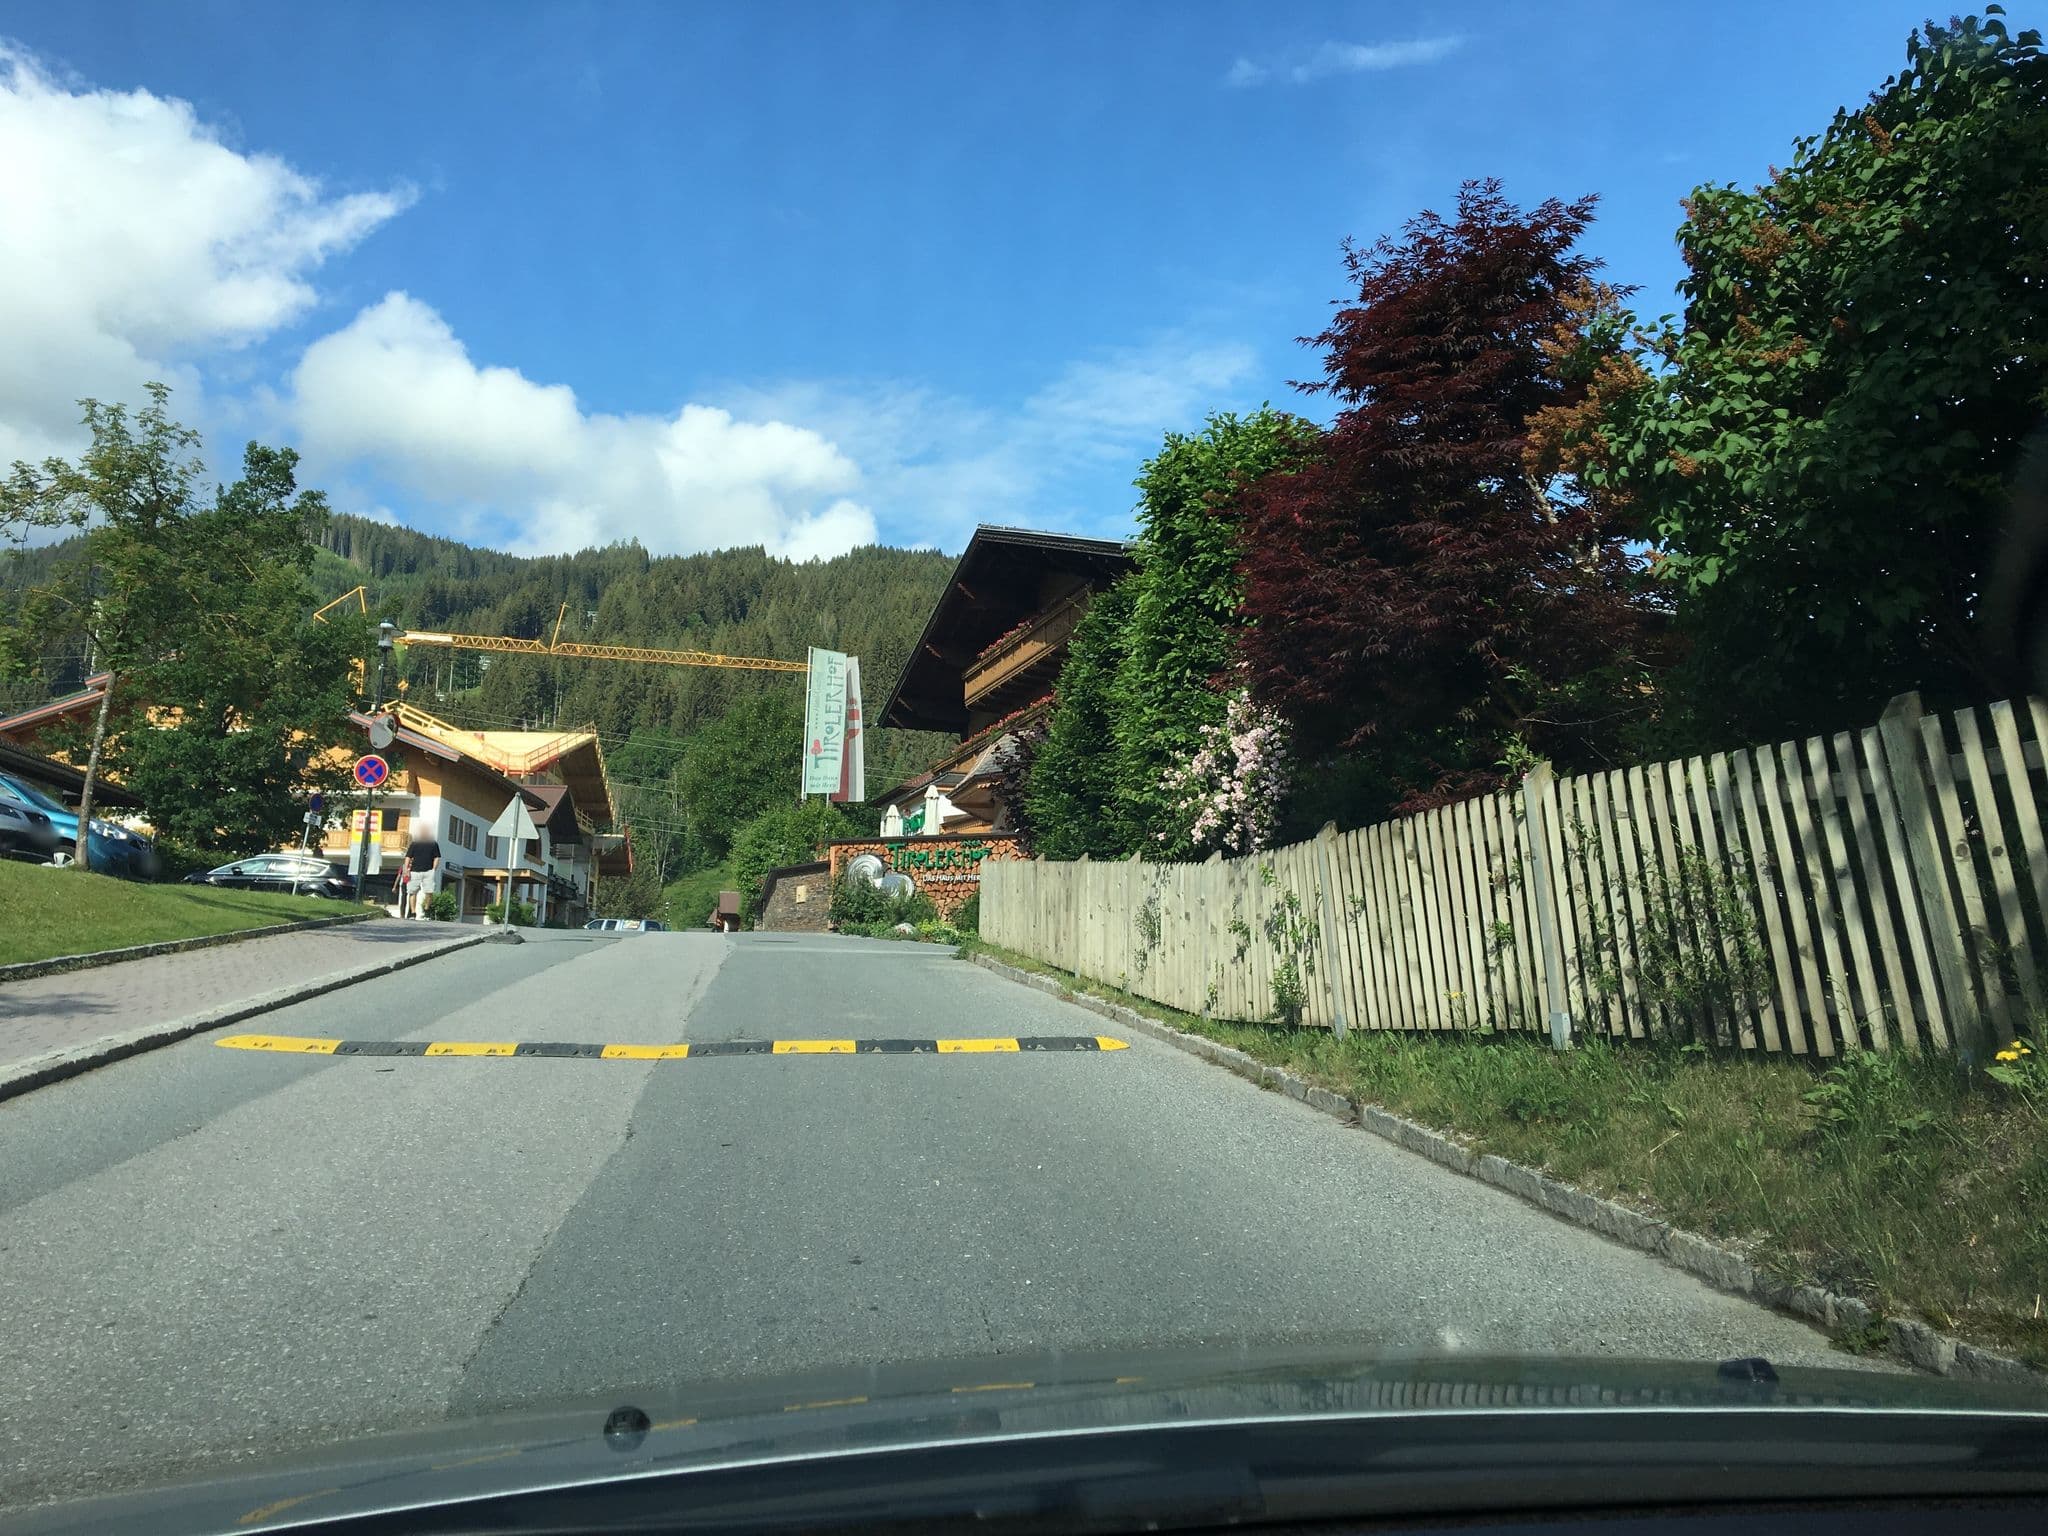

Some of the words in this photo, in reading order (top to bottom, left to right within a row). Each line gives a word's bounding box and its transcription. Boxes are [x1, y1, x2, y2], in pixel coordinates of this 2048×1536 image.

[923, 874, 935, 882] DAS
[936, 874, 954, 882] HAUS
[954, 874, 966, 883] MIT
[967, 873, 980, 882] HER
